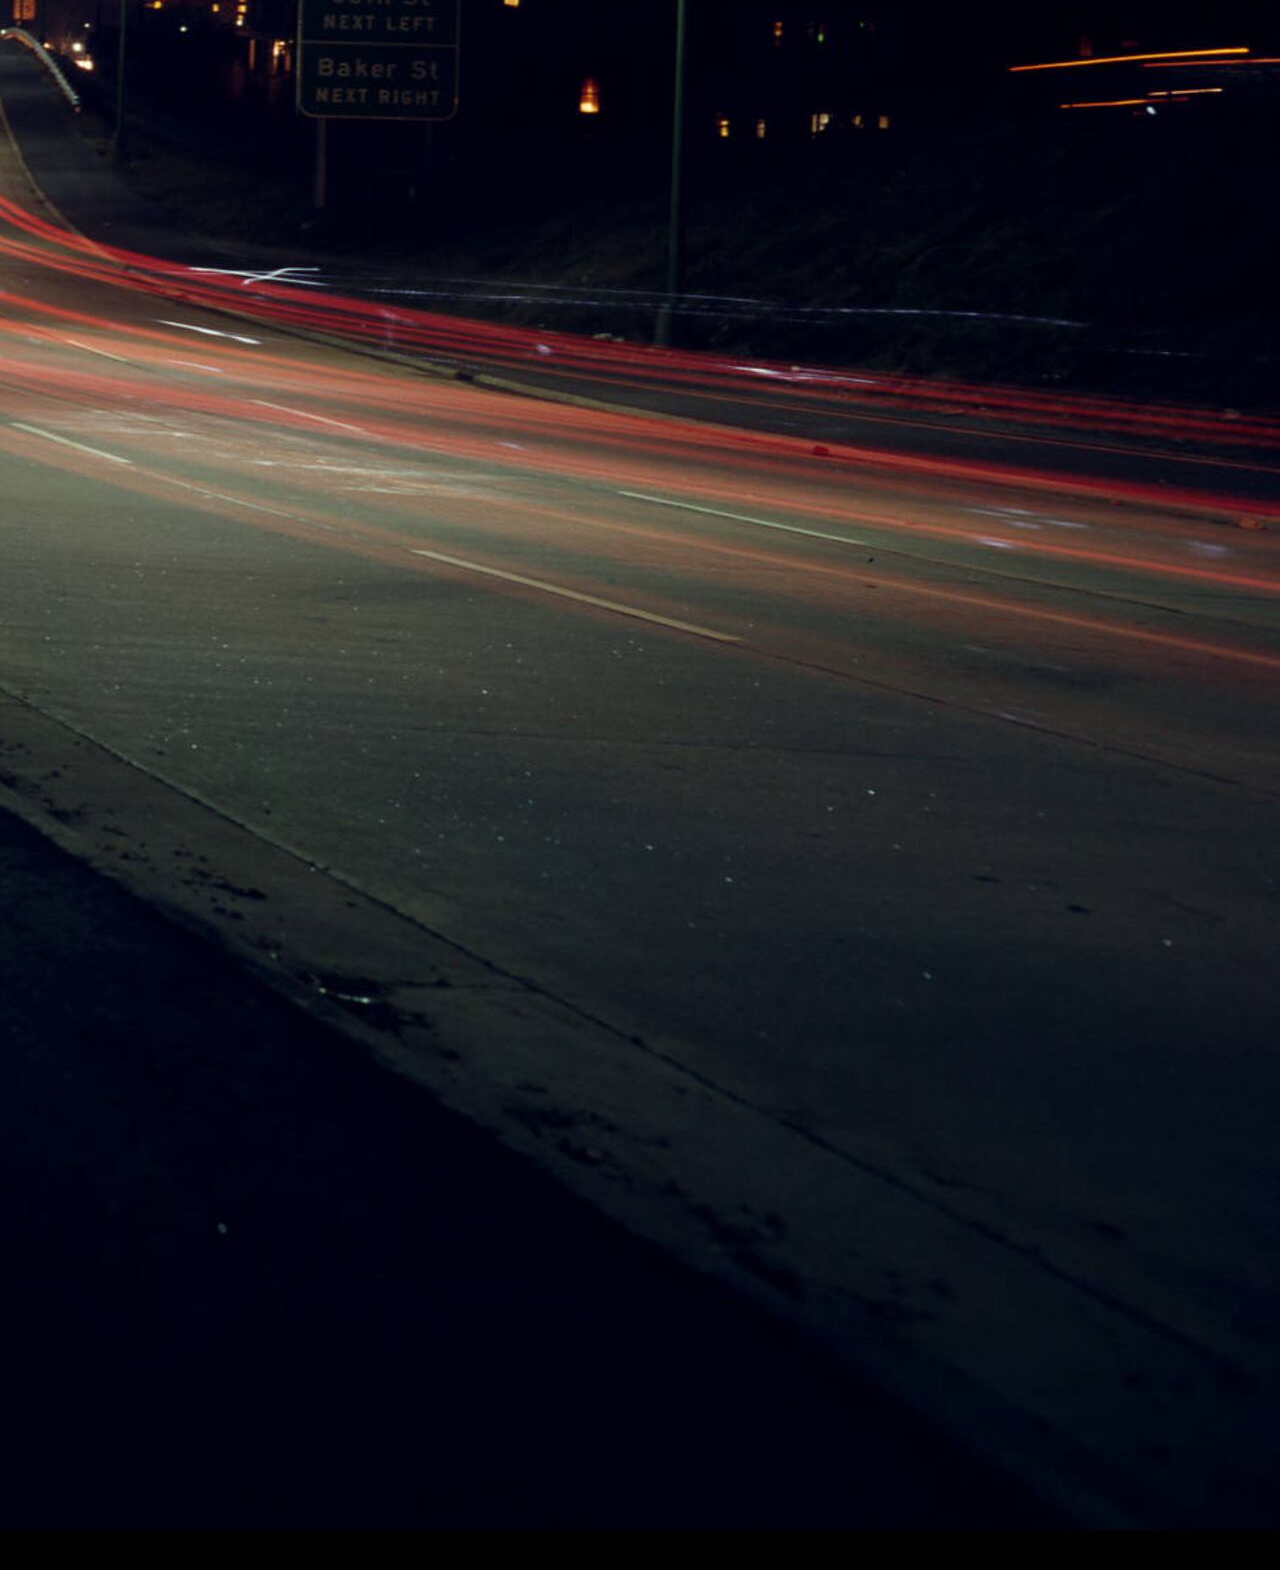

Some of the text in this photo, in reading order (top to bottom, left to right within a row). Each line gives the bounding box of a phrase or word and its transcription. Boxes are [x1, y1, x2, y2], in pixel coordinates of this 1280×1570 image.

[322, 13, 436, 32] NEXT LEFT
[317, 57, 440, 81] Baker St
[314, 86, 441, 106] NEXT RIGHT
